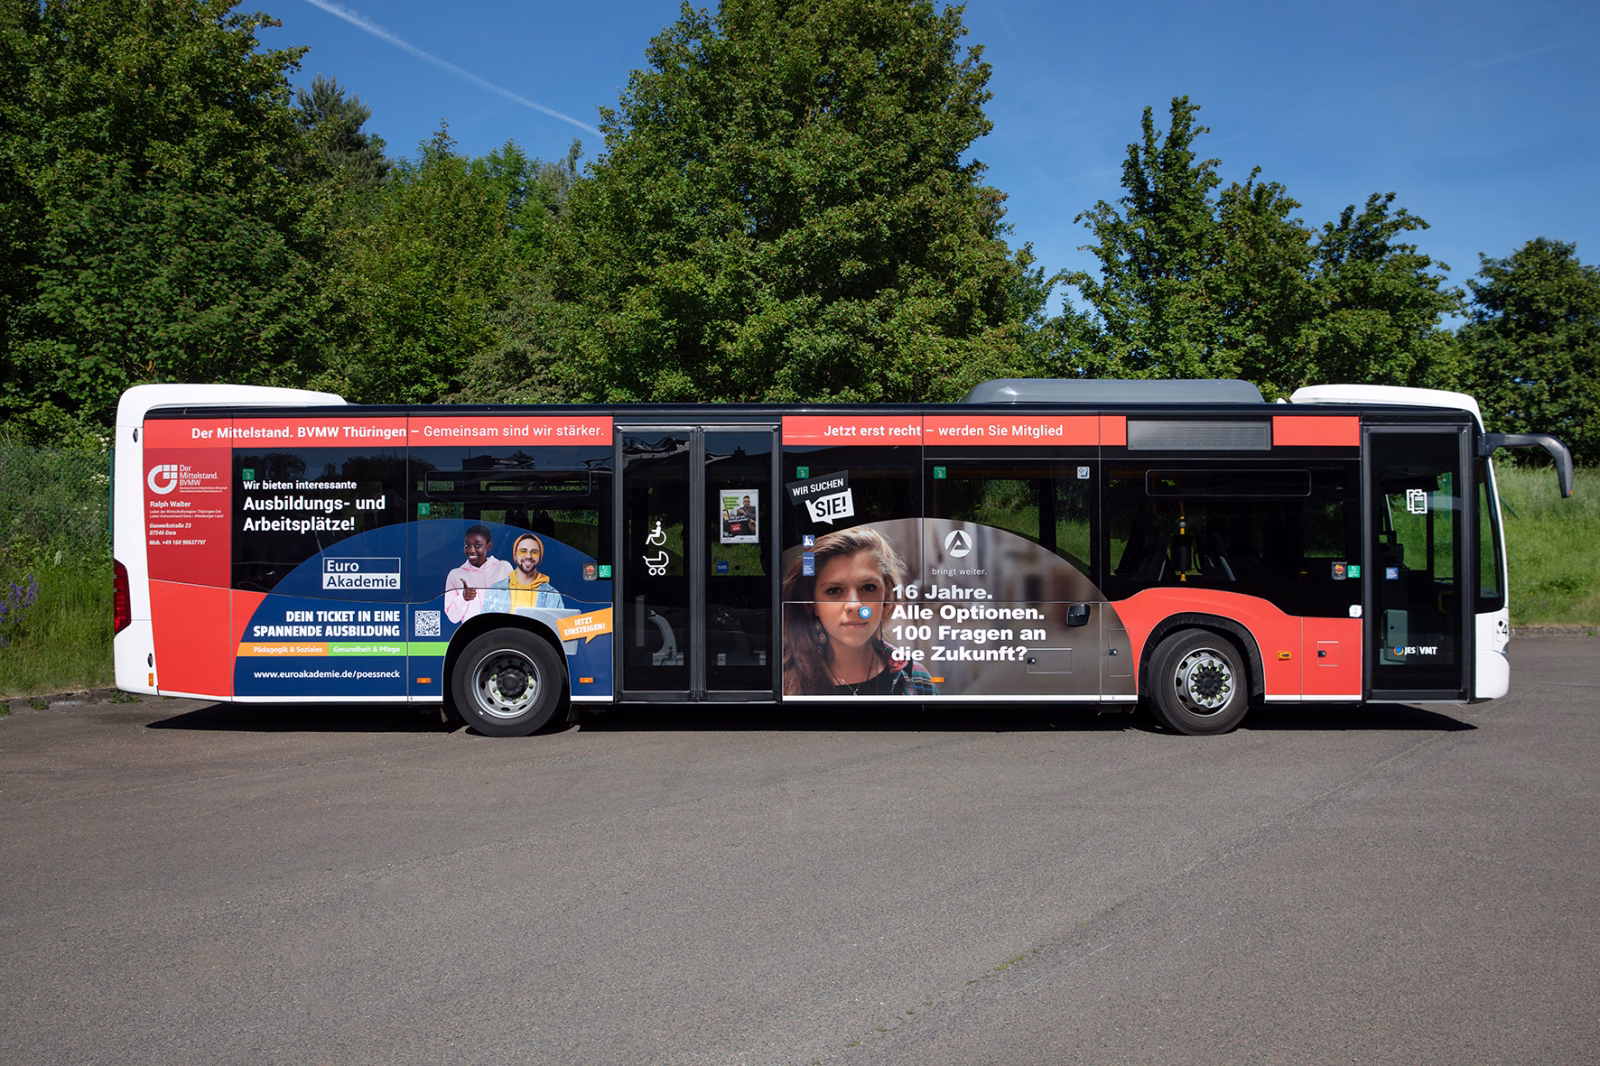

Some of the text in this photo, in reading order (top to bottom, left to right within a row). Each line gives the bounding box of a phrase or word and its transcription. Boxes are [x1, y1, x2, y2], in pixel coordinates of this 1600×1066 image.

[191, 427, 214, 439] Der
[217, 426, 294, 439] Mittelstand.
[297, 426, 339, 438] BVMW
[342, 426, 407, 440] Thüringen
[424, 425, 499, 437] Gemeinsam
[503, 425, 529, 436] sind
[533, 425, 552, 436] wir
[556, 425, 604, 436] stärker.
[824, 425, 857, 437] Jetzt
[860, 426, 885, 437] erst
[888, 425, 922, 437] recht
[938, 425, 984, 437] werden
[988, 425, 1008, 437] Sie
[1011, 425, 1064, 439] Mitglied
[180, 464, 192, 472] Der
[243, 480, 357, 490] Wir bieten interessante
[792, 478, 844, 497] WIR SUCHEN
[150, 501, 169, 509] Ralph
[243, 495, 386, 514] Ausbildungs- und
[815, 496, 847, 518] SIE!
[243, 516, 355, 535] Arbeitsplätze!
[326, 560, 360, 572] Euro
[931, 567, 957, 577] bringt
[326, 575, 398, 588] Akademie
[892, 584, 993, 600] 16 Jahre.
[285, 611, 401, 622] DEIN TICKET IN EINE
[890, 604, 1045, 623] Alle Optionen.
[573, 616, 593, 627] JETZT
[253, 625, 401, 637] SPANNENDE AUSBILDUNG
[563, 622, 606, 637] EINSTEIGEN!
[892, 625, 1047, 644] 100 Fragen an
[253, 646, 288, 654] Pädagogik
[380, 646, 401, 655] Pflege
[891, 646, 1028, 661] die Zukunft?
[1419, 647, 1438, 655] VMT
[253, 670, 401, 680] www.euroakademie.de/poessneck
